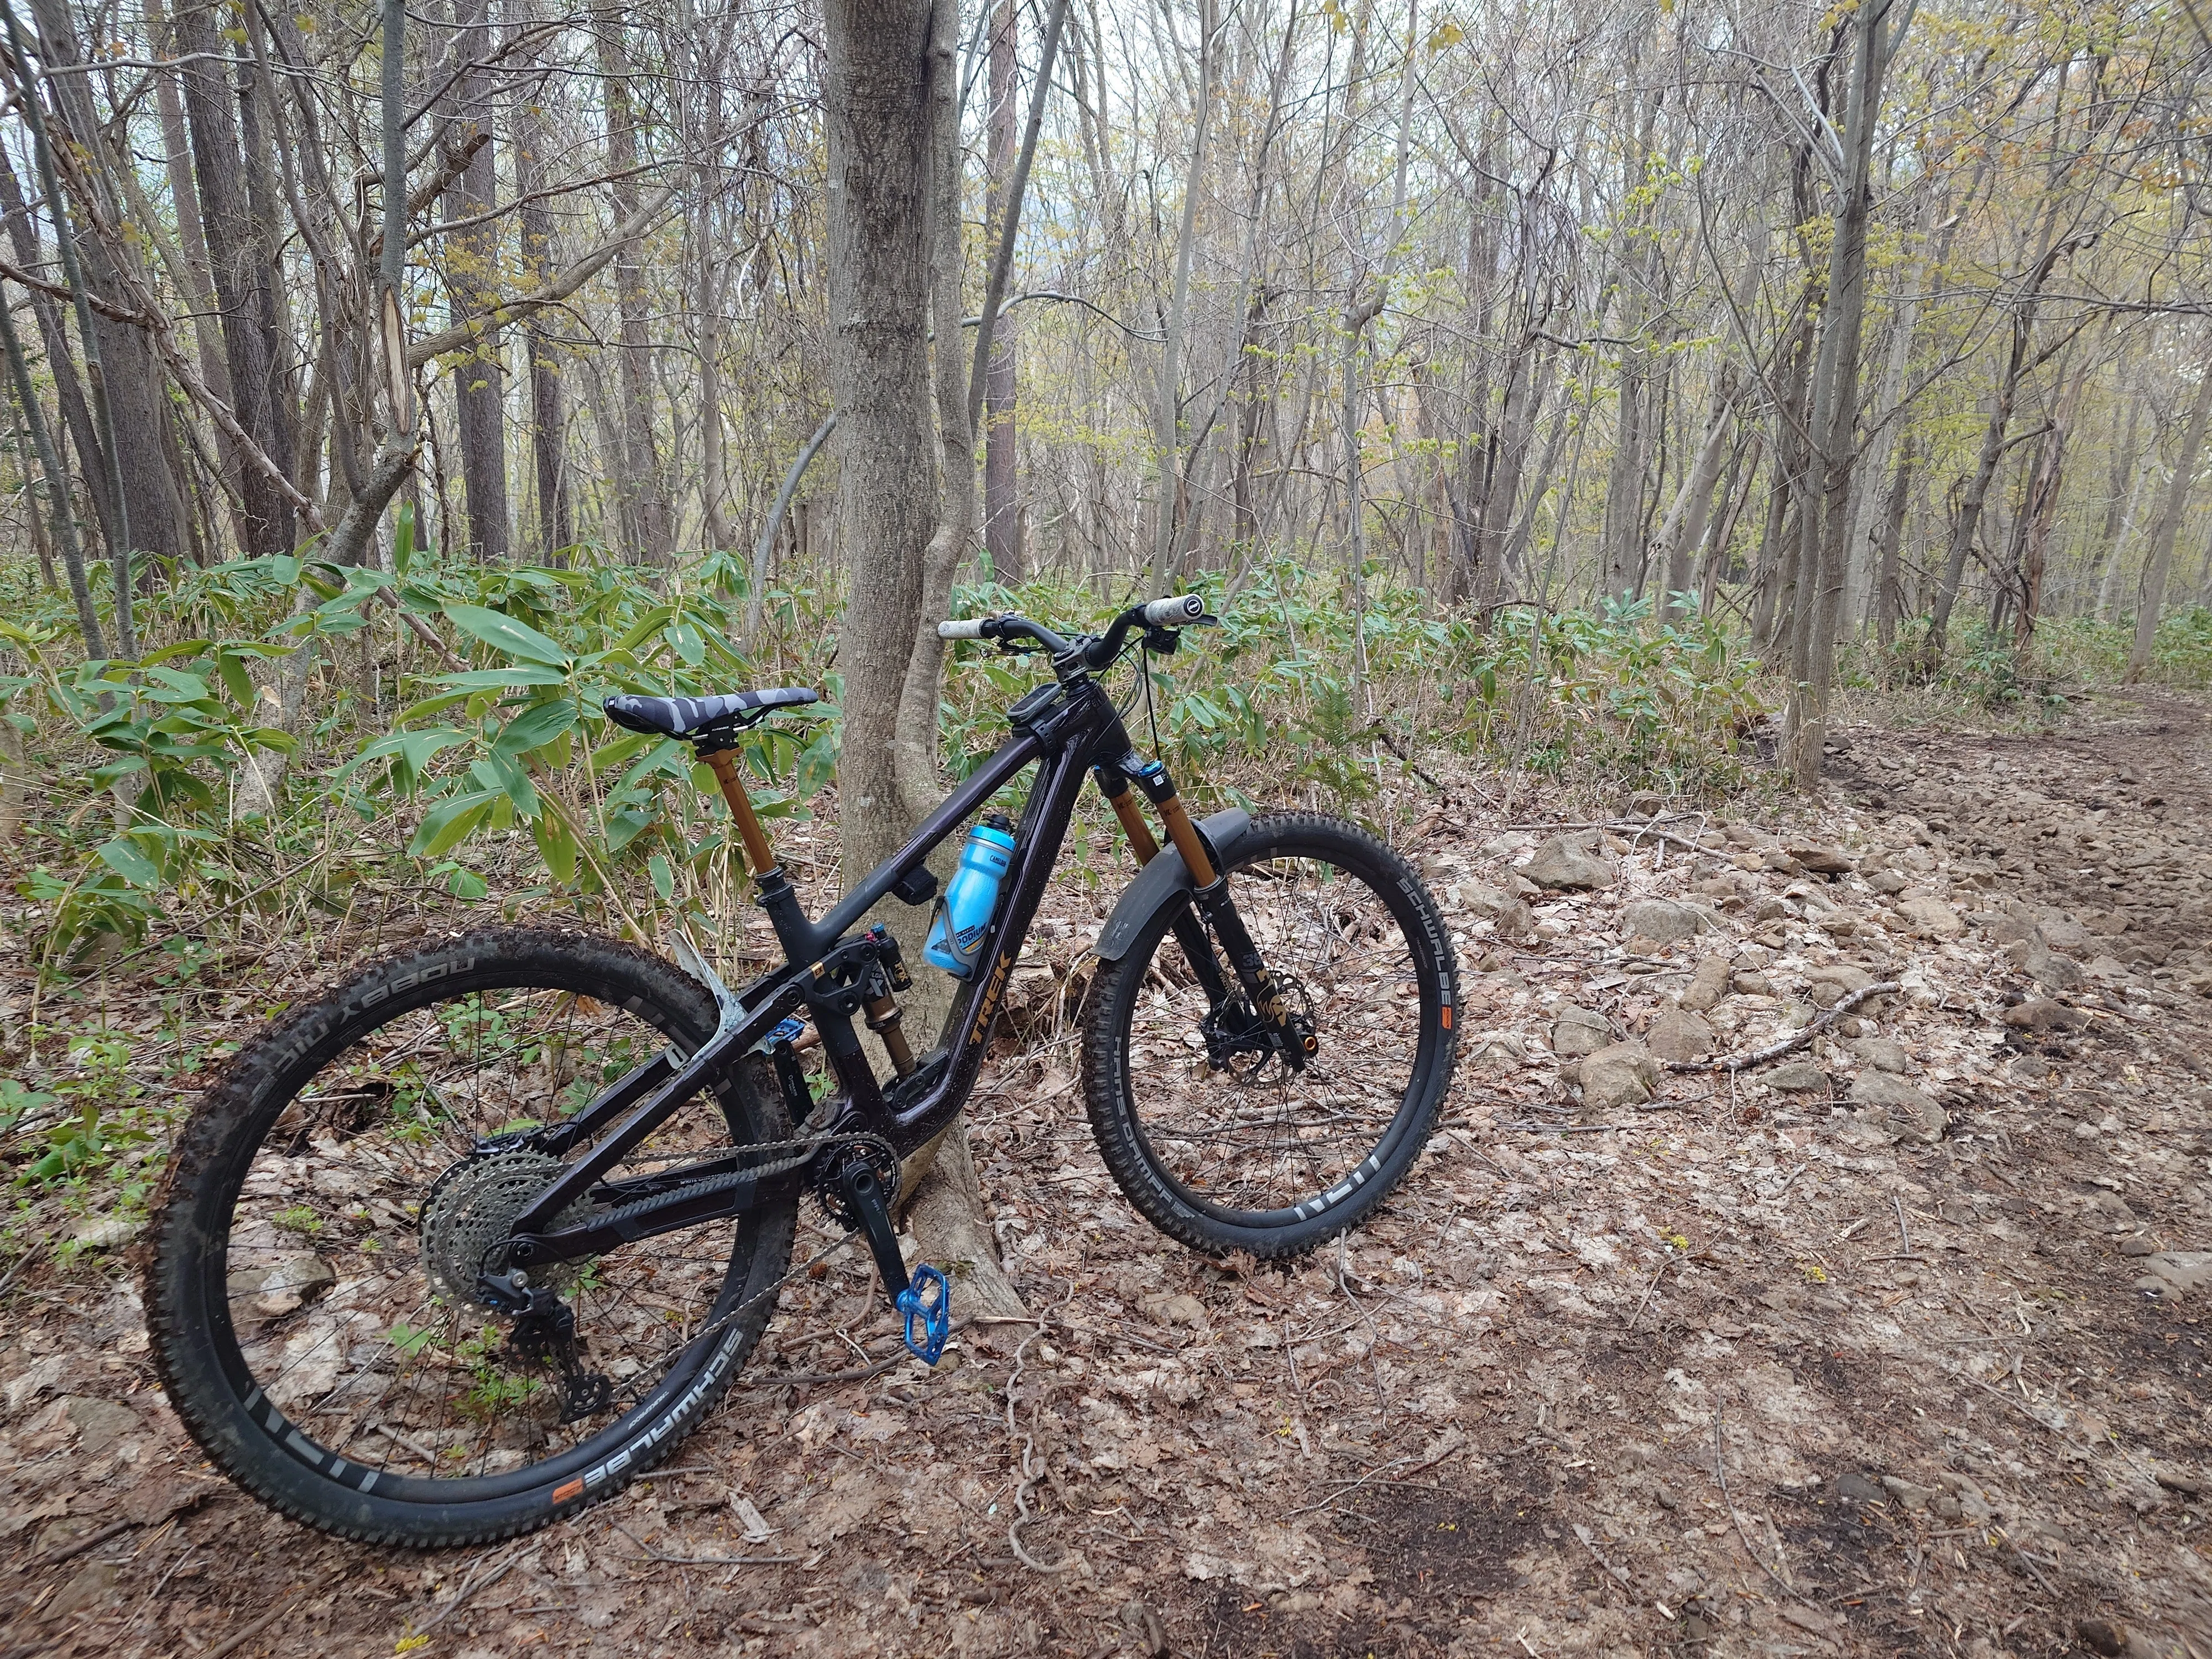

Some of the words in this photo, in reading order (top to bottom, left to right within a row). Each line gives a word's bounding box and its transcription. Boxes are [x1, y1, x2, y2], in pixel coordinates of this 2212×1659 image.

[815, 966, 823, 976] EX
[894, 962, 909, 983] FOX
[1396, 877, 1452, 1005] SCHWALBE
[340, 957, 476, 1025] NOBBY
[969, 950, 1011, 1045] TREK
[1113, 1036, 1127, 1117] HANS
[1121, 1121, 1173, 1203] DAMPF
[585, 1328, 744, 1487] SCHWALBE
[628, 1392, 667, 1431] NUKEPROOF
